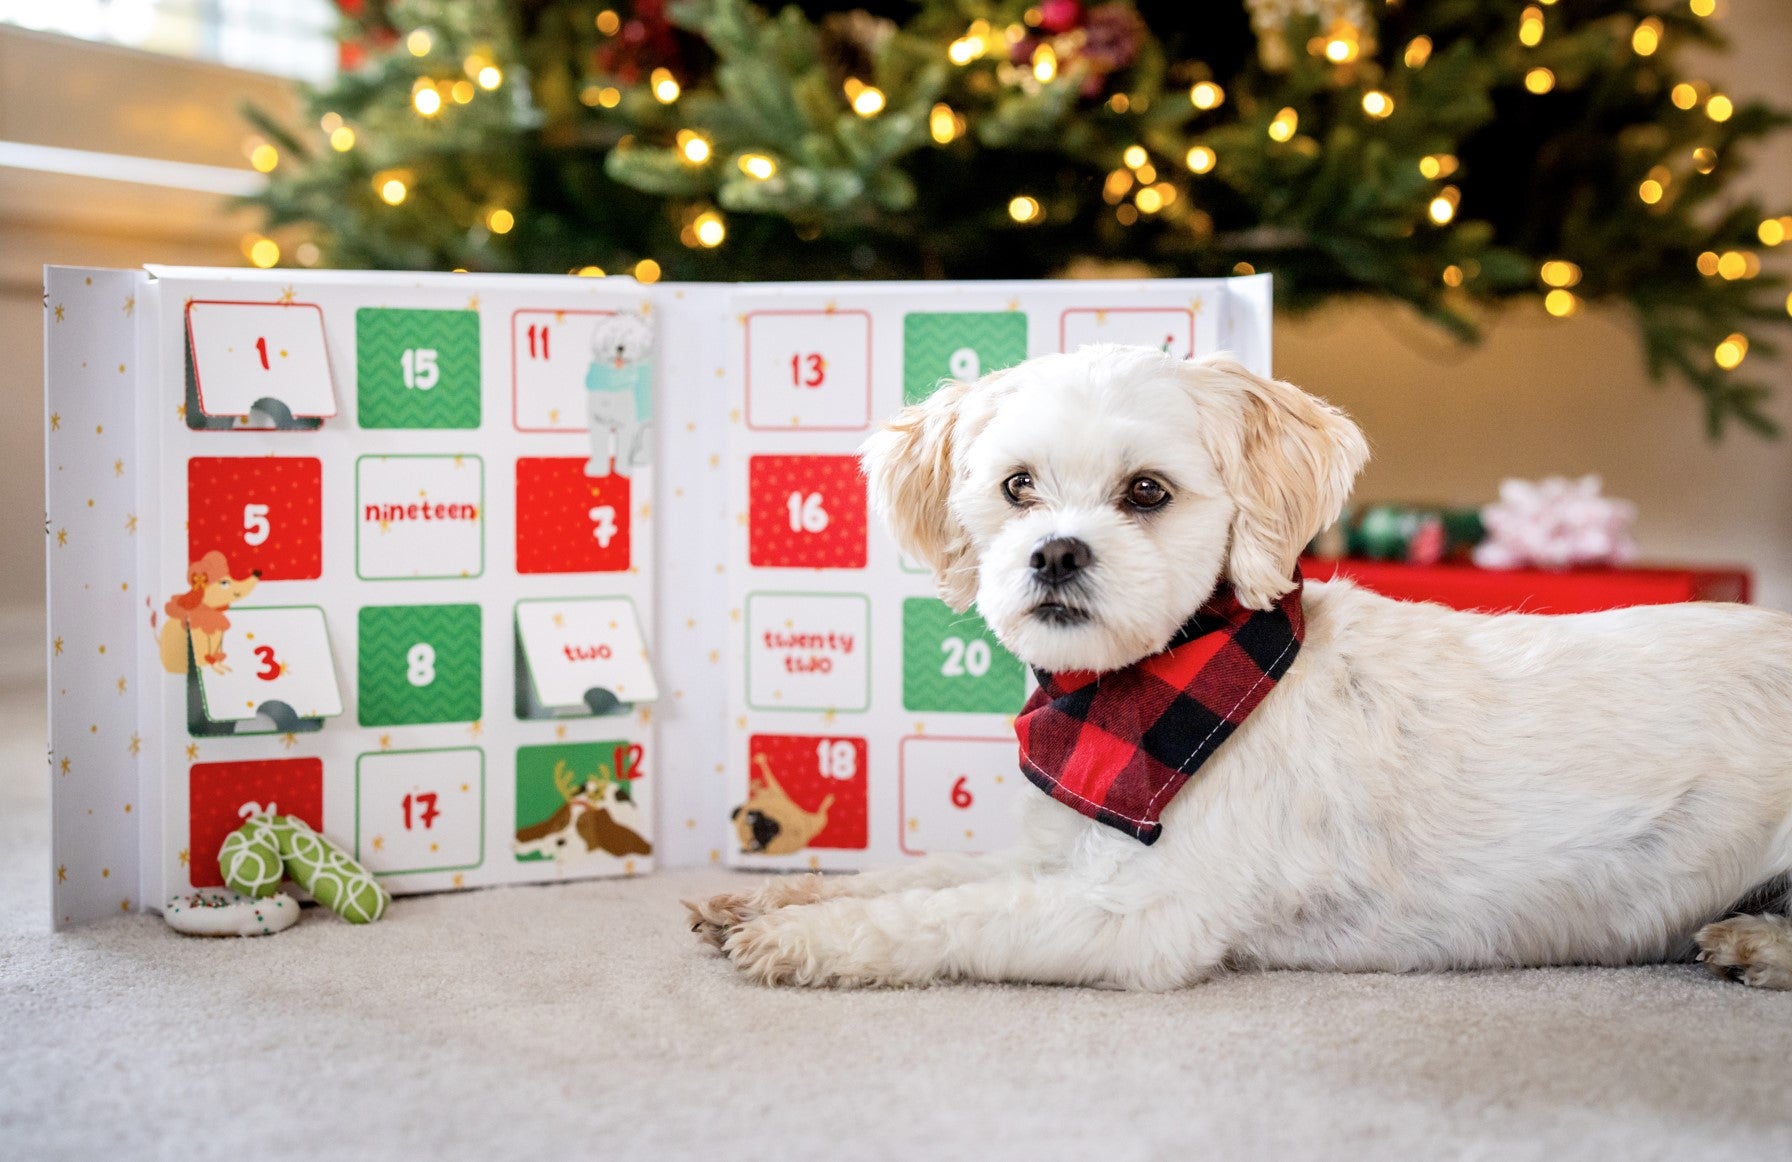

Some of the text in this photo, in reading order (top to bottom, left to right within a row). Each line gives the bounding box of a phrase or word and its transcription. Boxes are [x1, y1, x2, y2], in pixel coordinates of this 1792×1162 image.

[256, 337, 269, 370] 1
[527, 325, 551, 360] 11
[401, 348, 440, 391] 15
[790, 353, 826, 388] 13
[948, 347, 980, 382] 9
[243, 504, 270, 546] 5
[365, 500, 476, 522] nineteen
[589, 505, 618, 548] 7
[786, 491, 829, 533] 16
[563, 642, 613, 662] two
[763, 630, 854, 654] twenty
[940, 637, 991, 677] 20
[253, 645, 281, 682] 3
[406, 643, 436, 687] 8
[784, 655, 833, 674] two
[612, 743, 645, 781] 12
[816, 739, 856, 780] 18
[950, 776, 974, 809] 6
[402, 793, 440, 831] 17
